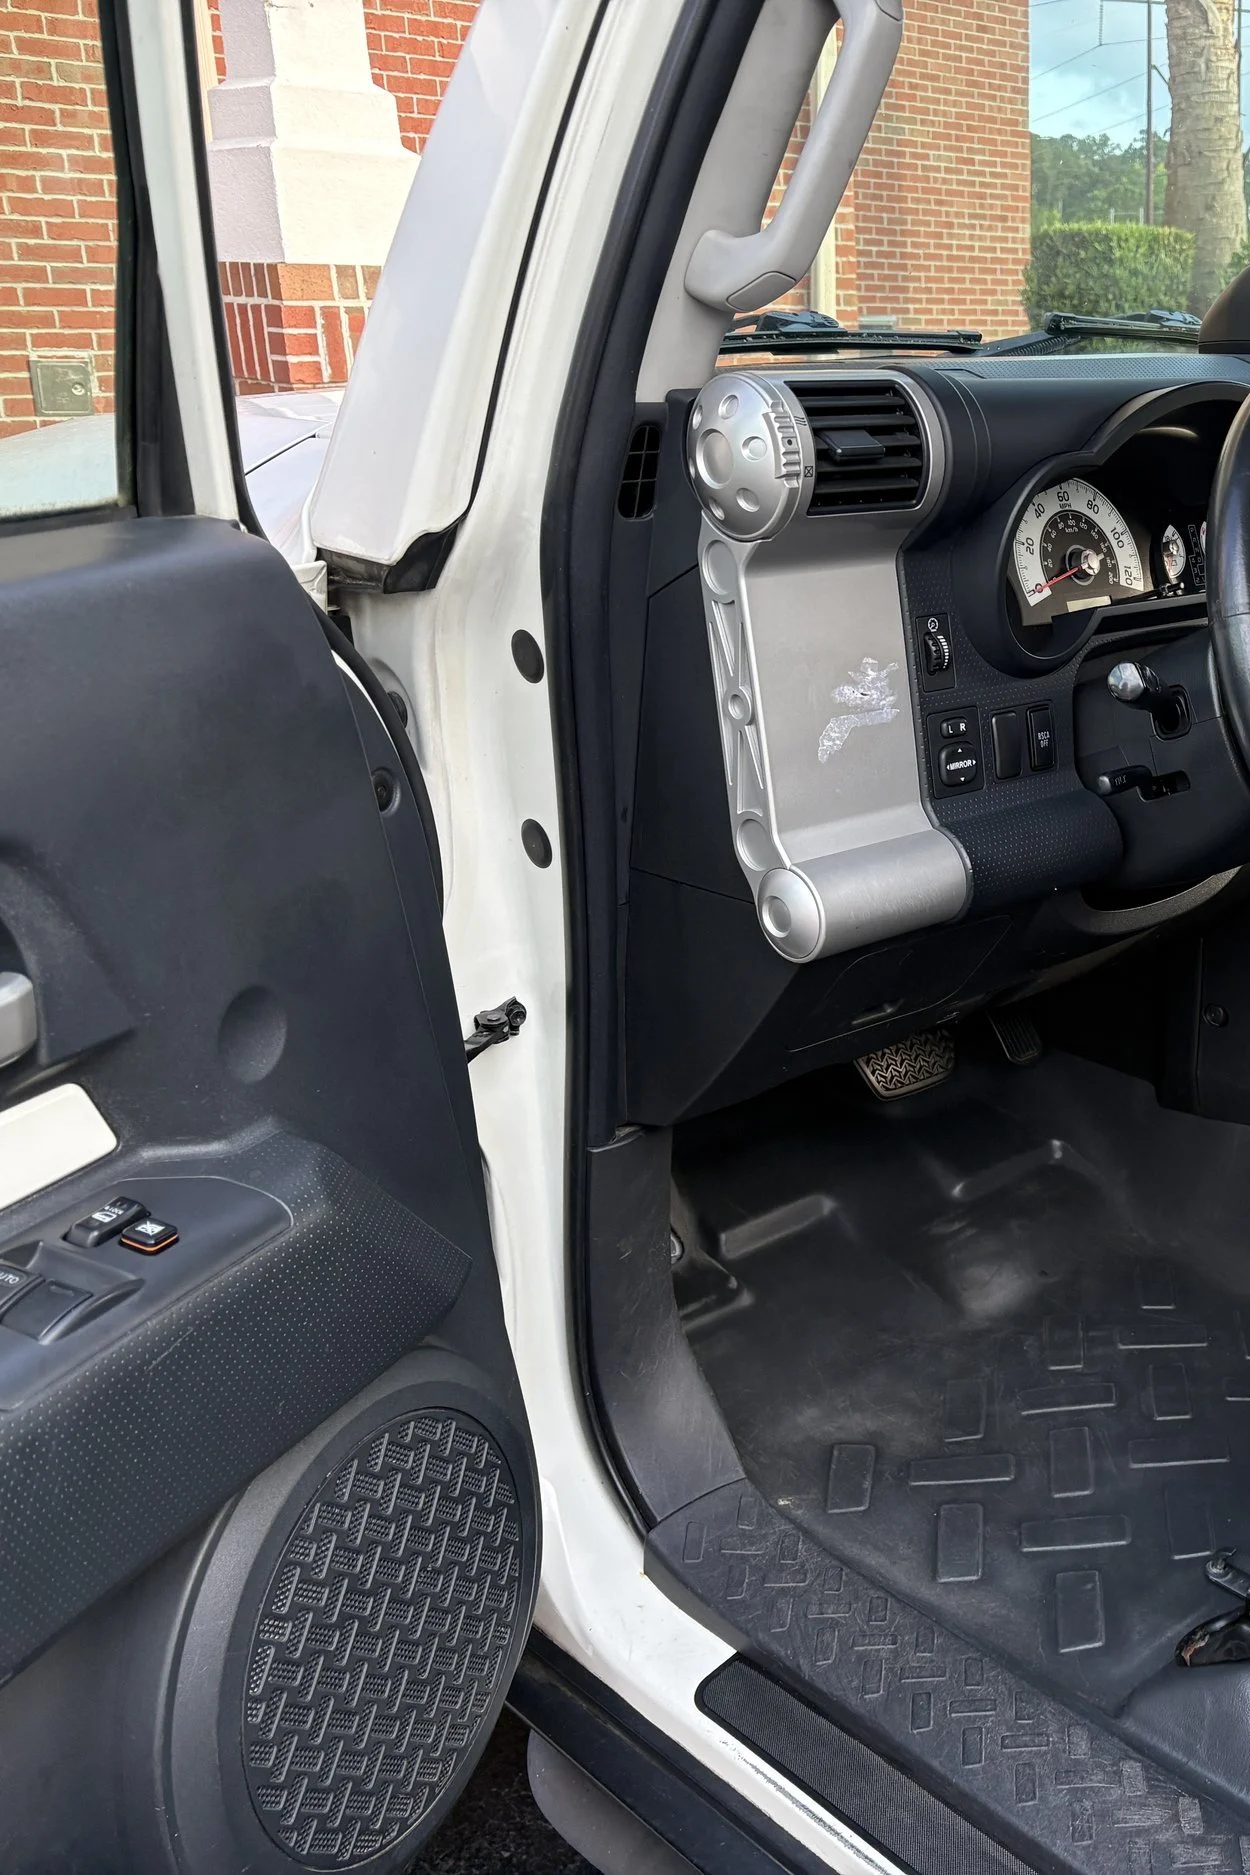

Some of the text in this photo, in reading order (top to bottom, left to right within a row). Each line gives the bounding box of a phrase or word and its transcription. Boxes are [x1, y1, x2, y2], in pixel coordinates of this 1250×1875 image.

[1057, 491, 1069, 502] 60
[1033, 503, 1046, 519] 40
[1086, 499, 1100, 515] 80
[1079, 522, 1088, 530] 120
[1110, 526, 1125, 549] 100
[1025, 537, 1035, 555] 20
[1123, 565, 1133, 586] 120
[948, 722, 966, 734] L R
[949, 759, 972, 771] MIRROR
[0, 1271, 19, 1284] UTO
